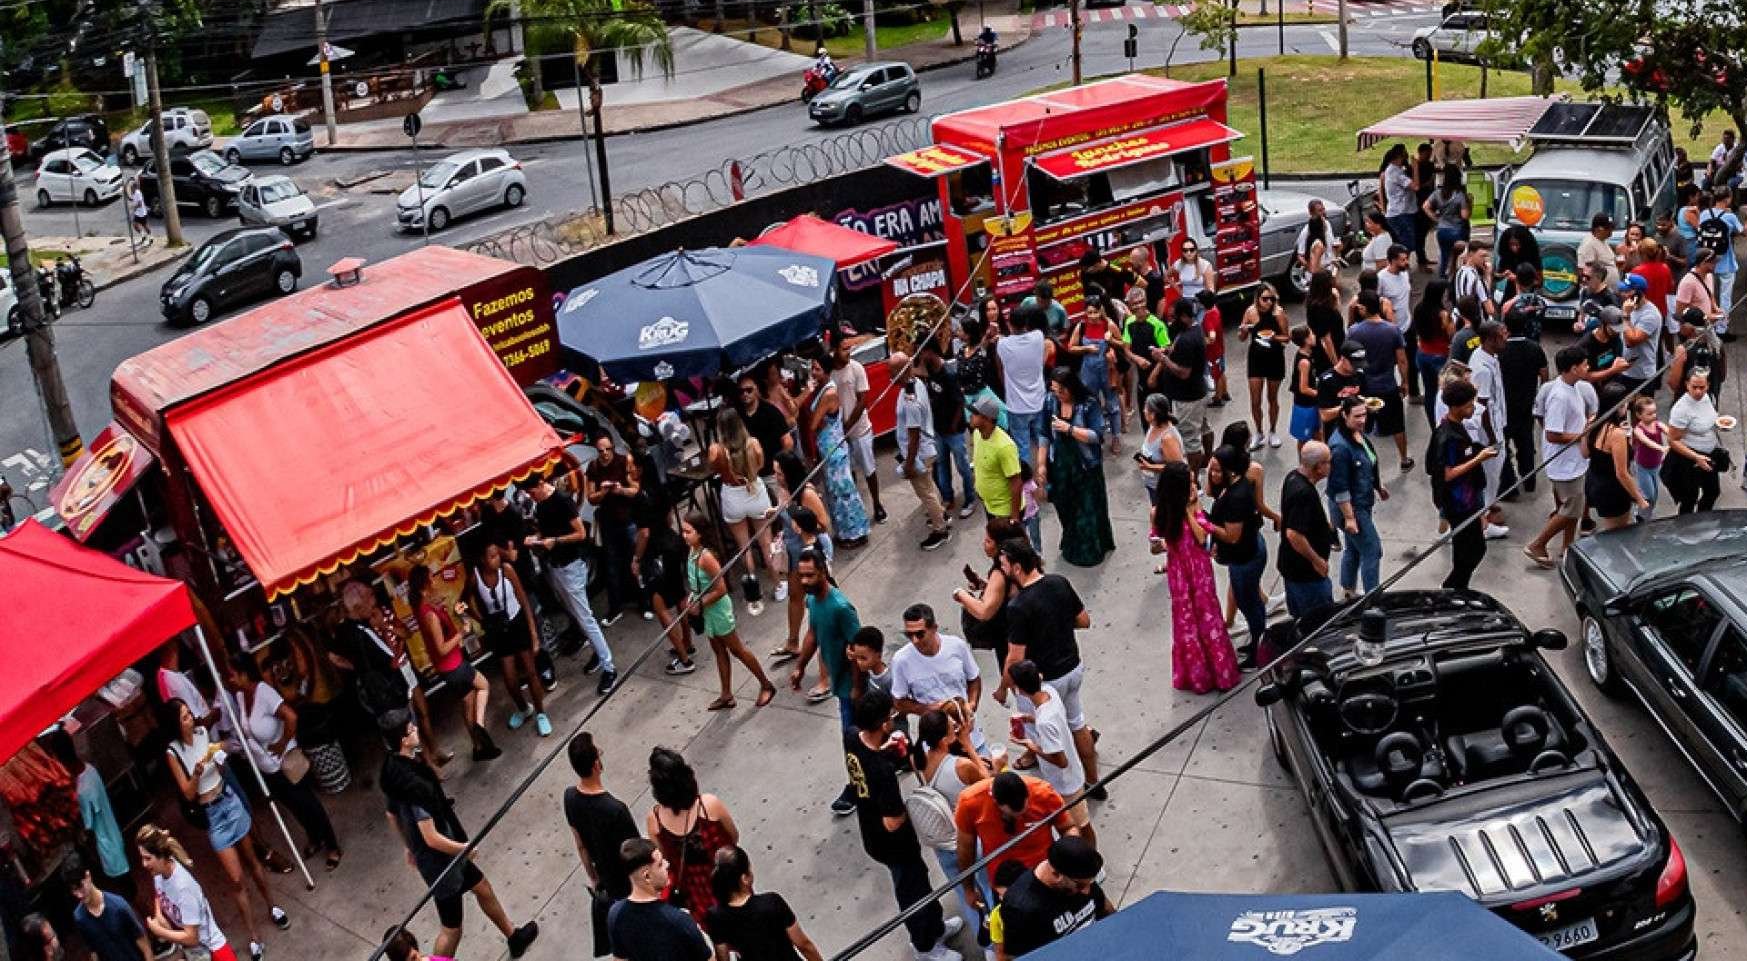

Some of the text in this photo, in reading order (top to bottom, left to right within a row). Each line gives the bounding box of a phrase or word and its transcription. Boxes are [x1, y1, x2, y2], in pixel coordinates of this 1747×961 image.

[473, 287, 534, 320] Fazemos
[482, 309, 535, 339] eventos
[1227, 917, 1357, 942] KRUG
